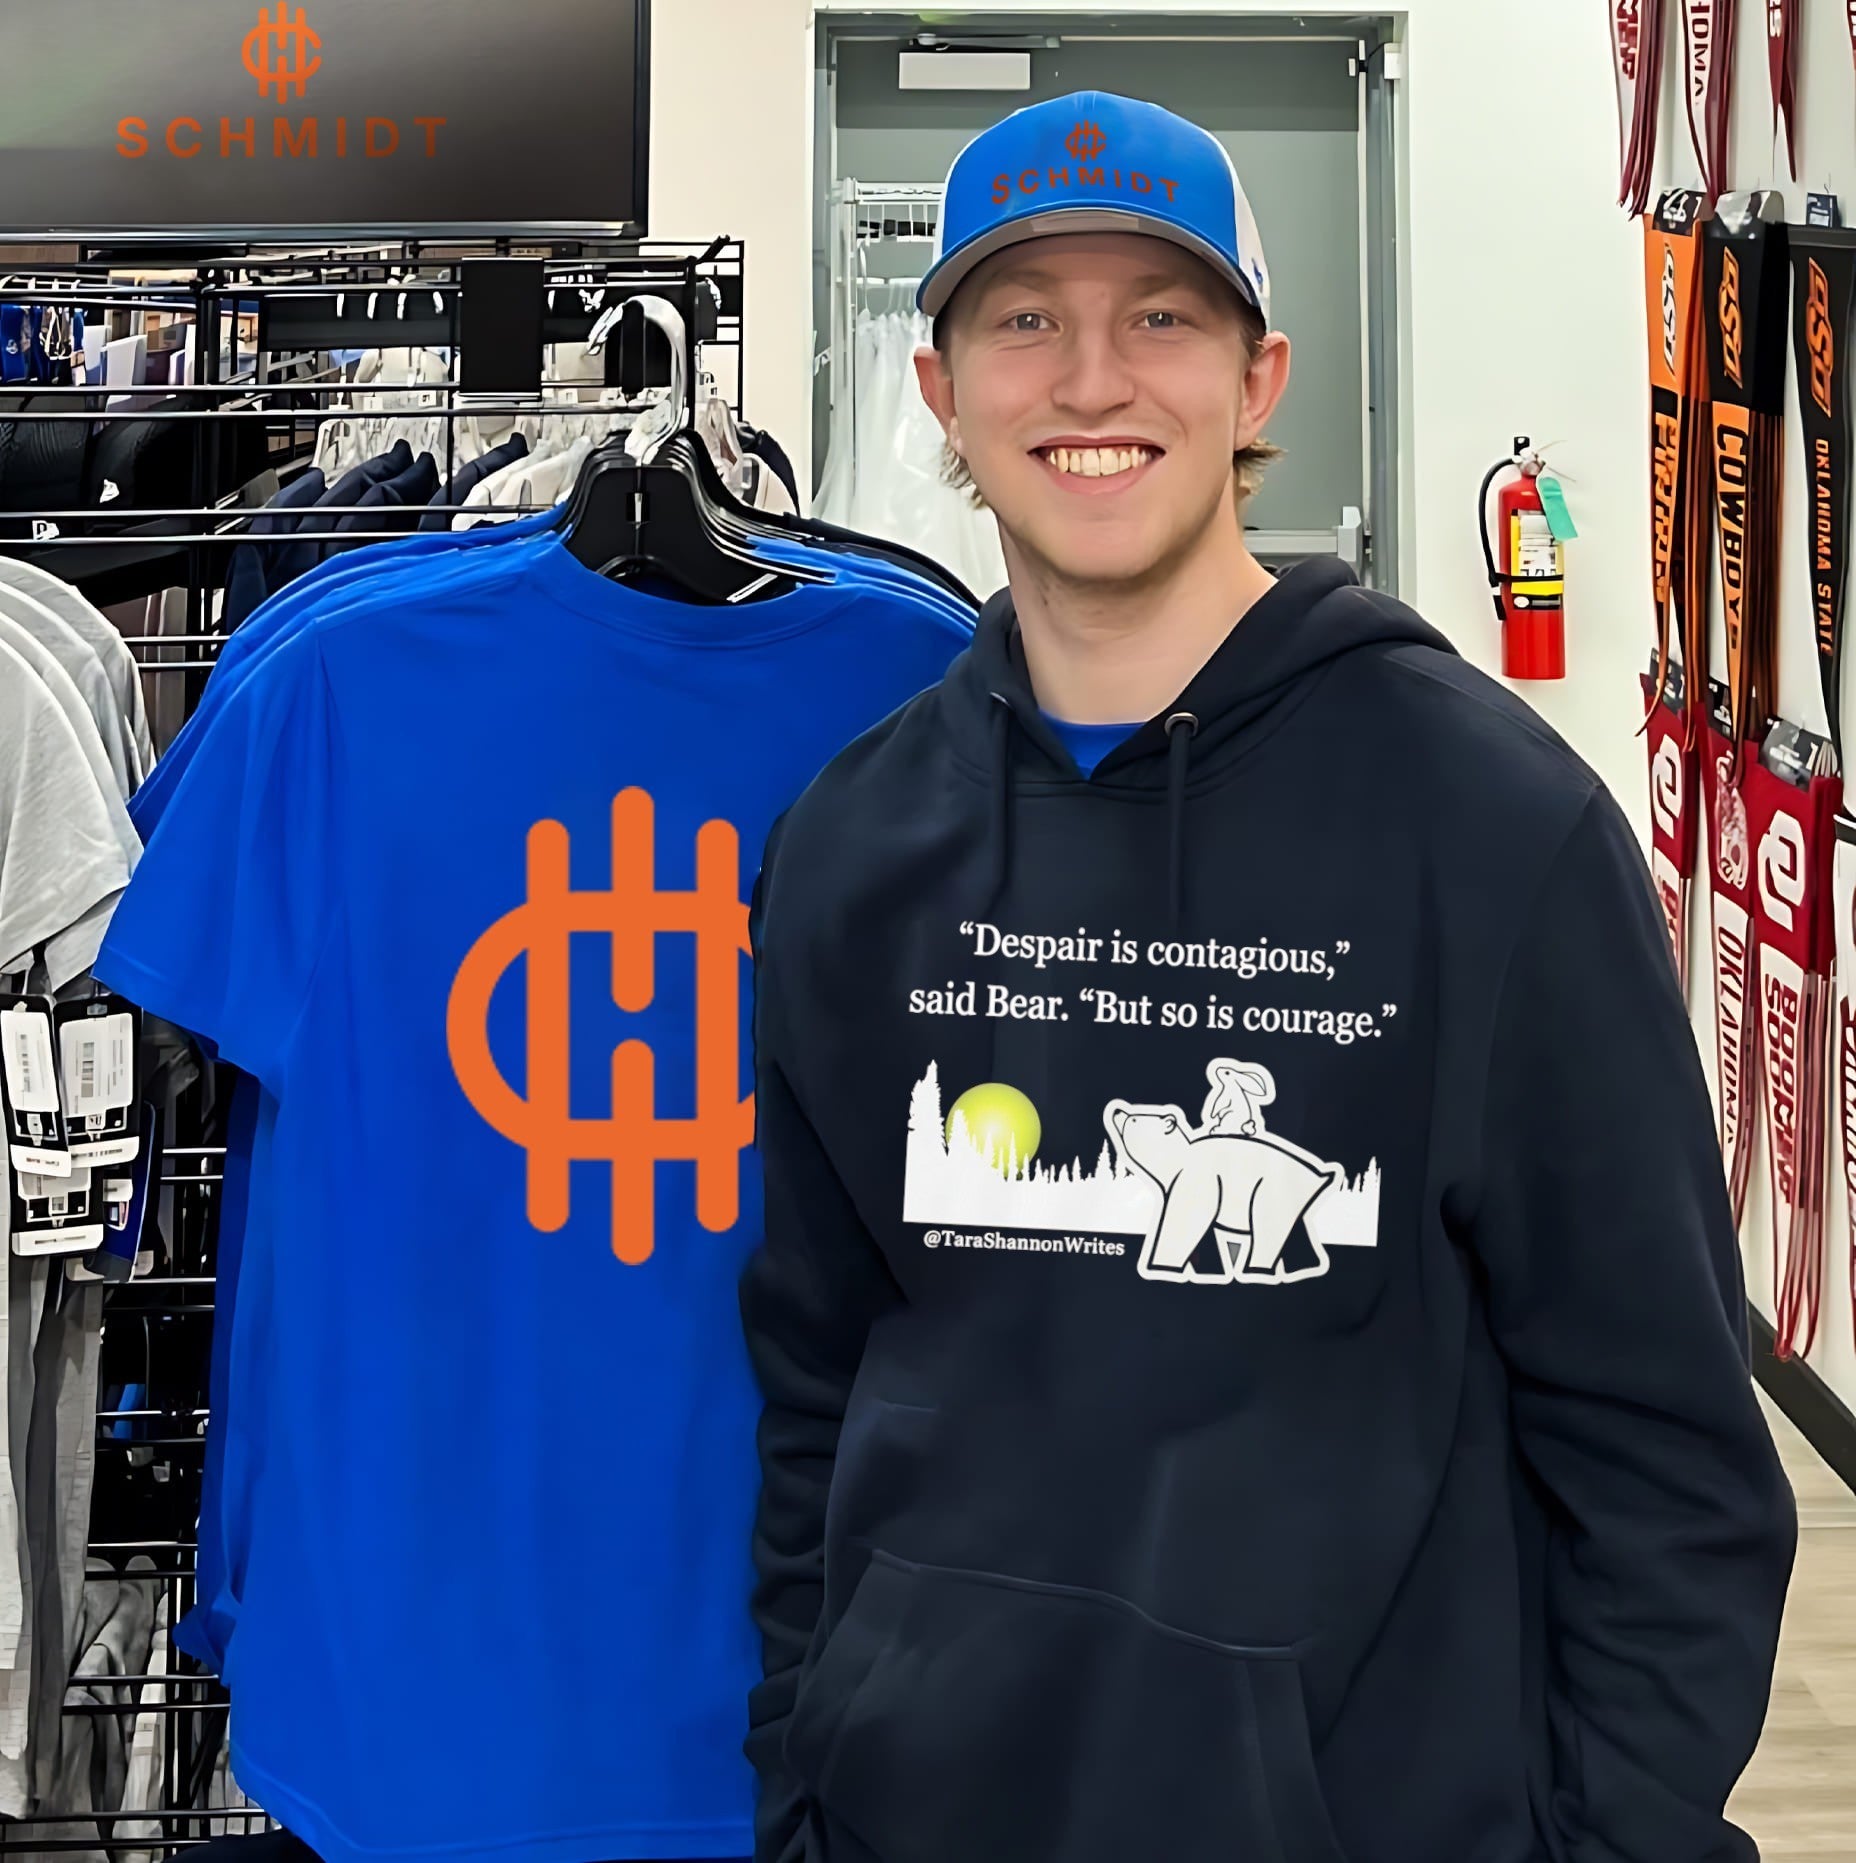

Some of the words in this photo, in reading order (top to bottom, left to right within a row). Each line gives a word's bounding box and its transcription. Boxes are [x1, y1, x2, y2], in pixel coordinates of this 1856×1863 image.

[115, 116, 447, 159] SCHMIDT
[992, 167, 1179, 204] SCHMIDT
[1815, 438, 1832, 570] OKLAHOMA
[1817, 583, 1833, 657] STATE
[959, 921, 1104, 969] “Despair
[1110, 928, 1138, 964] is
[1147, 936, 1351, 981] contagious,”
[908, 980, 977, 1017] said
[985, 984, 1069, 1022] Bear.
[1079, 987, 1153, 1026] “But
[1160, 1002, 1198, 1028] so
[1206, 994, 1234, 1030] is
[1242, 1003, 1398, 1045] courage.”
[1719, 926, 1746, 1144] OKLAHOMA
[923, 1229, 1125, 1256] @TaraShannonWrites
